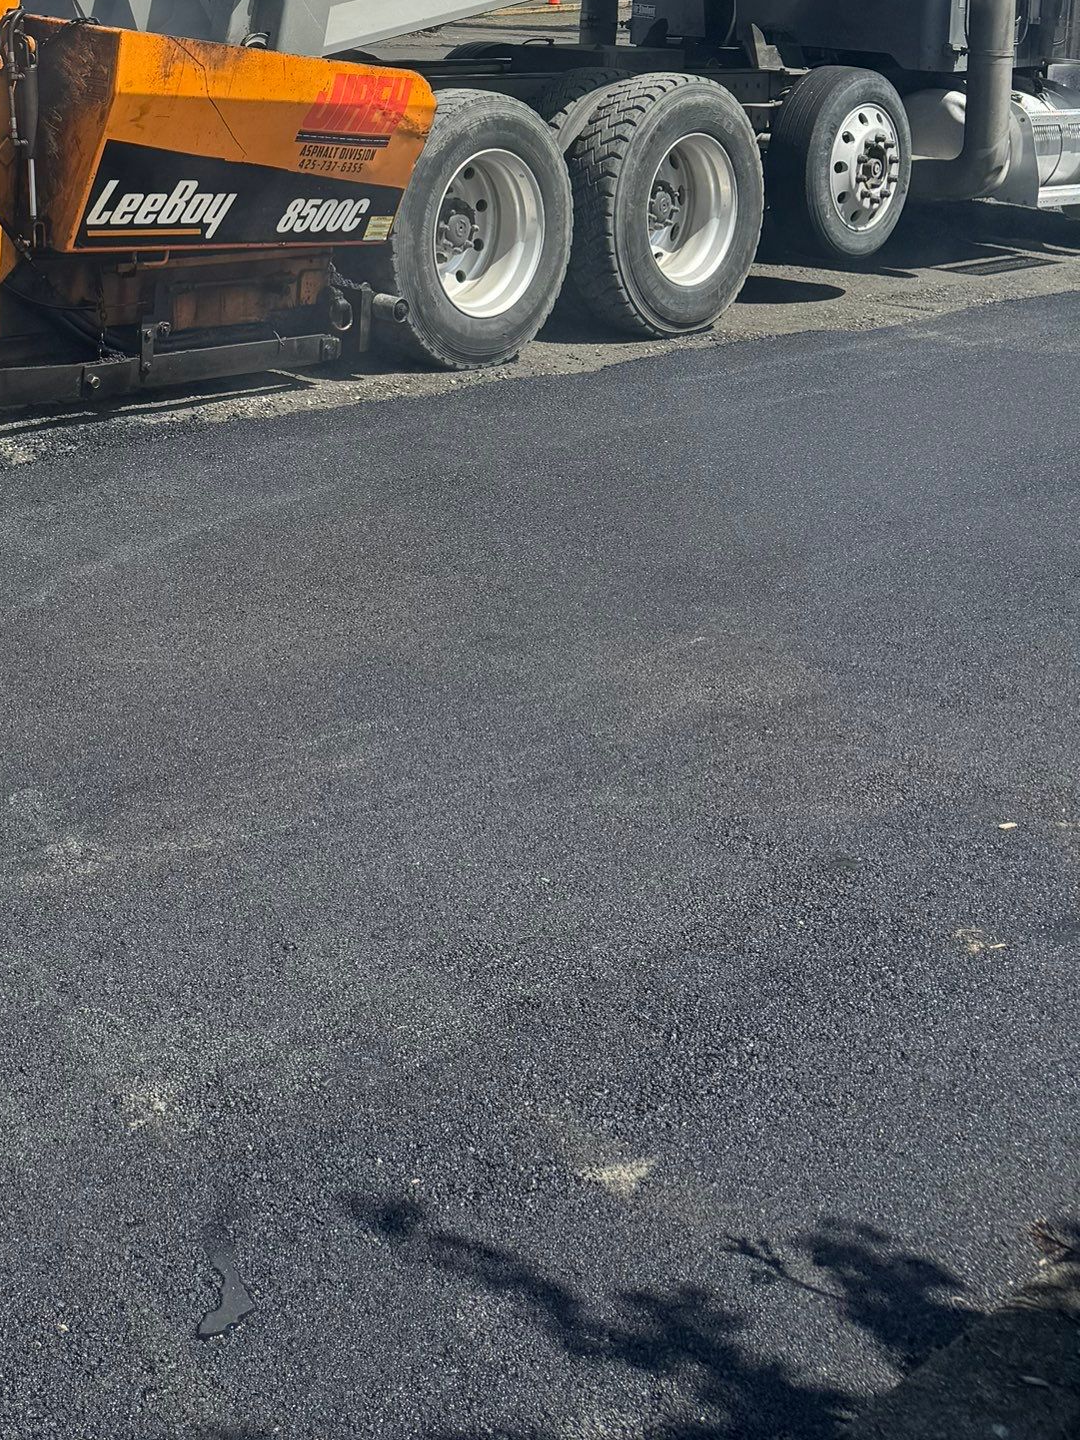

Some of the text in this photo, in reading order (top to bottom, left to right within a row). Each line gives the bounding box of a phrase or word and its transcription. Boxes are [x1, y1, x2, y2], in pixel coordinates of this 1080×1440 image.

[300, 145, 377, 161] ASPHALT DIVISION
[298, 158, 363, 173] 425-737-6355
[86, 179, 238, 239] LeeBoy
[276, 198, 371, 233] 8500C
